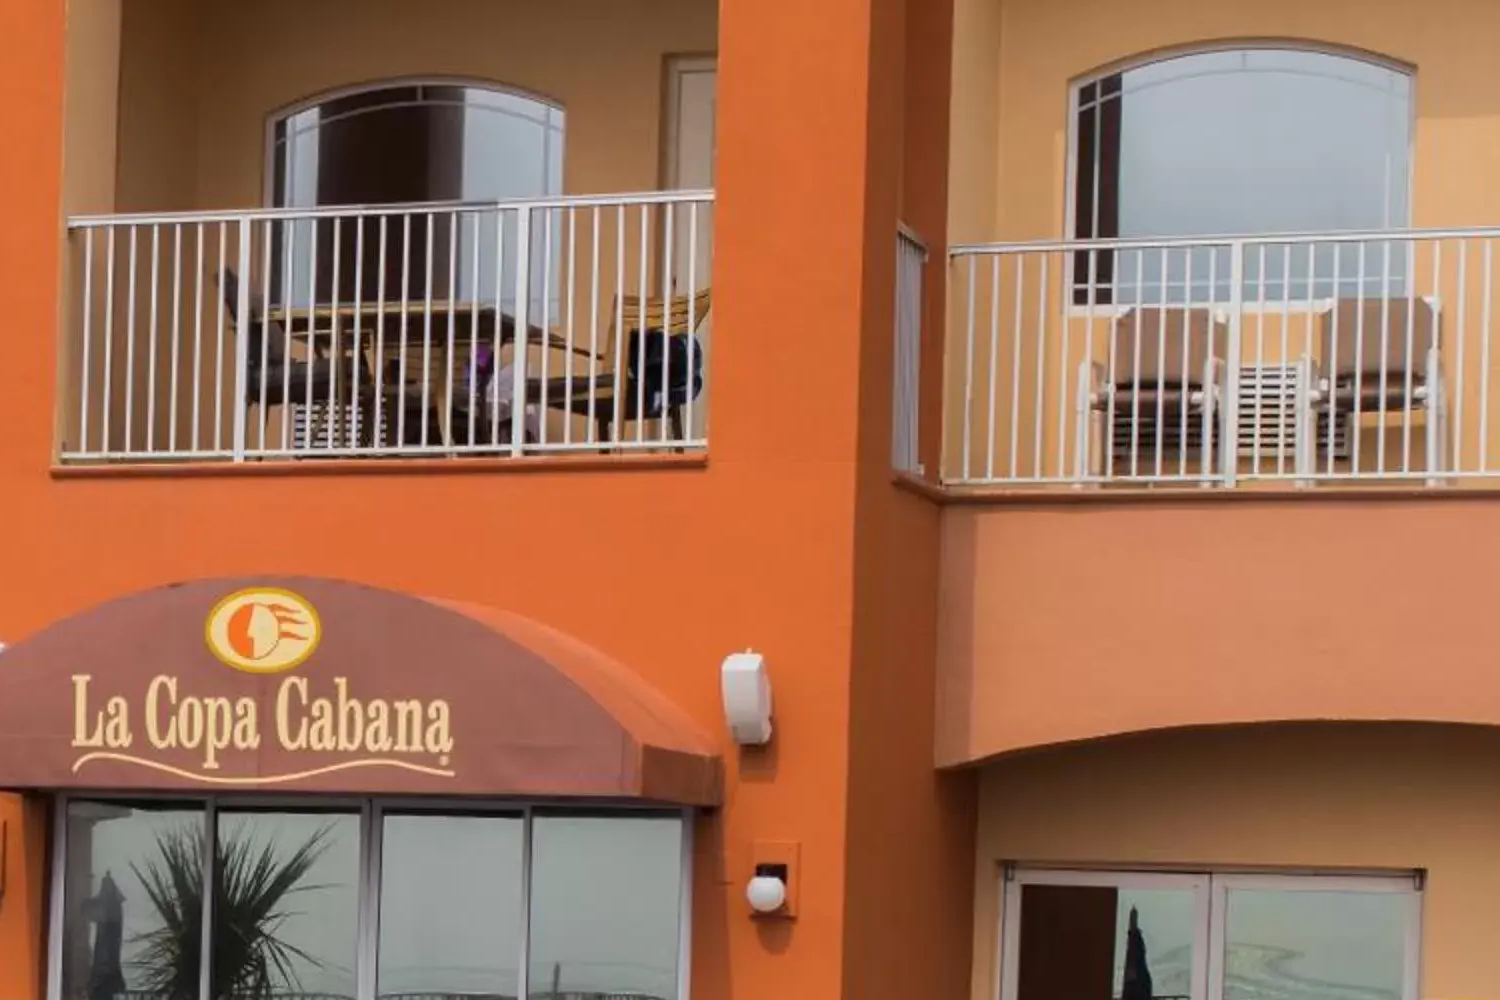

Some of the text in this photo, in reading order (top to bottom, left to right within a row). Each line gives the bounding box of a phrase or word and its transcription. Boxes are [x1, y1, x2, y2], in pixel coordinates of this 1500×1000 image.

[71, 674, 454, 769] La Copa Cabana
